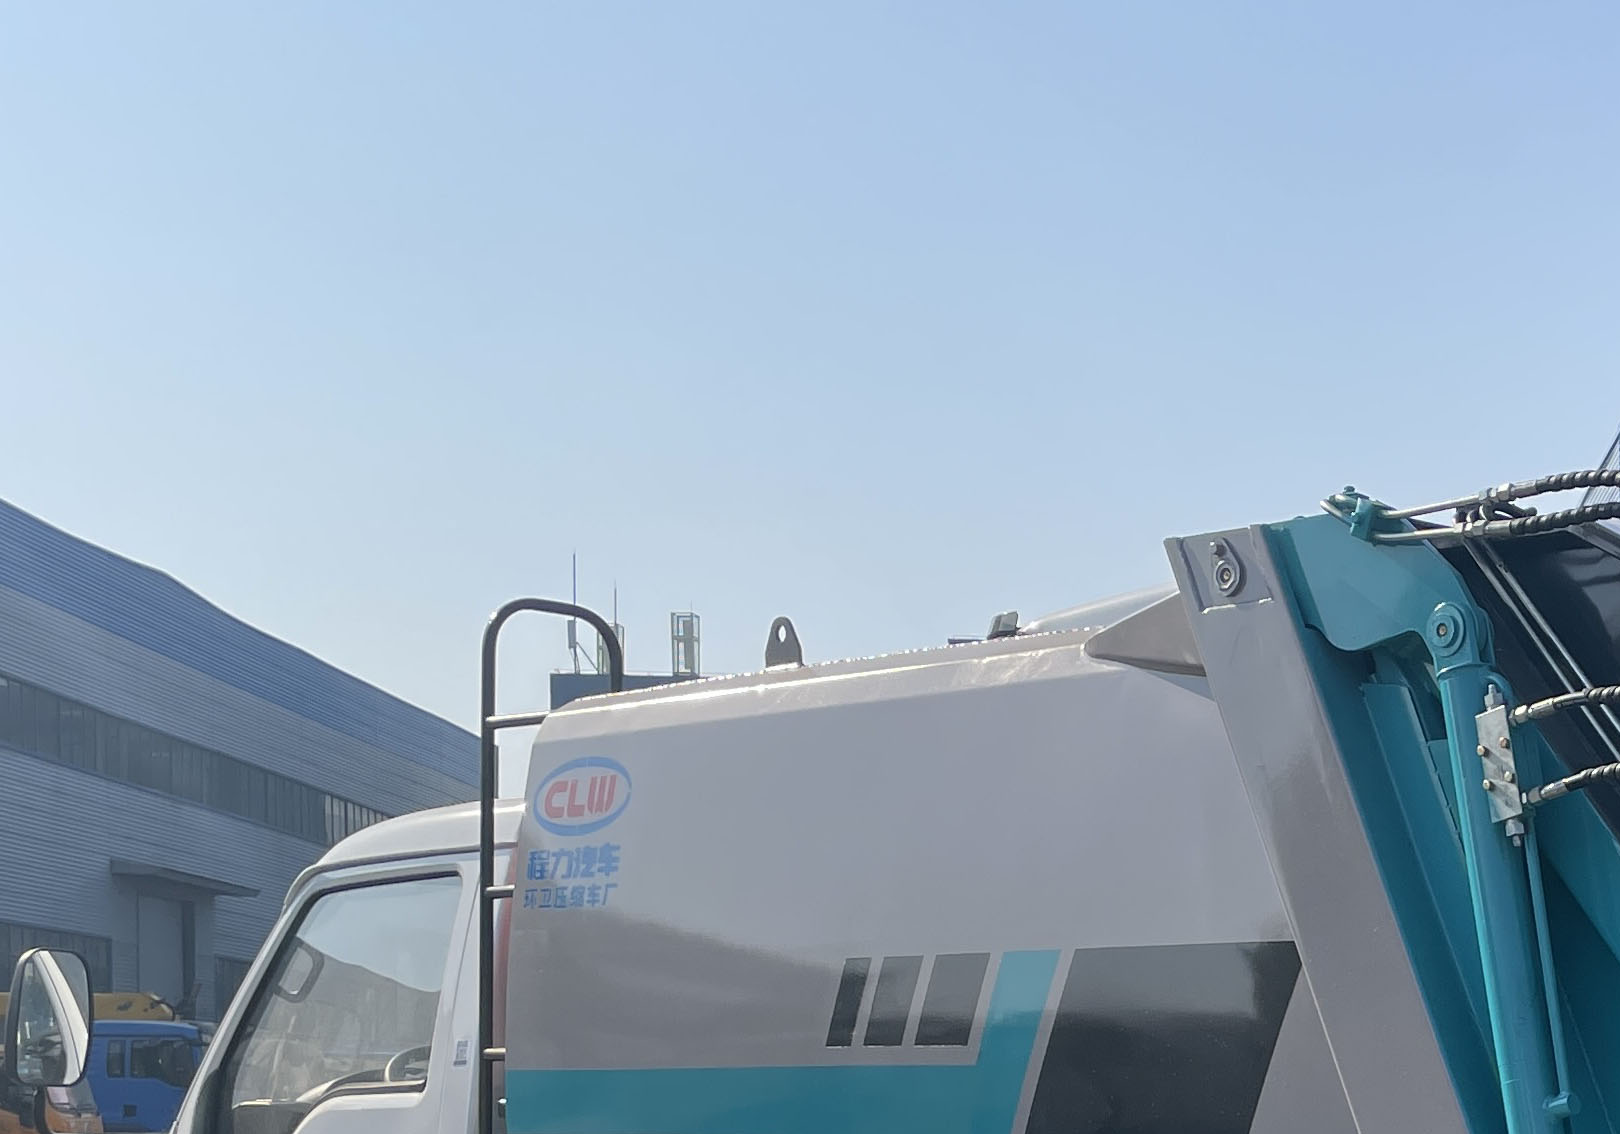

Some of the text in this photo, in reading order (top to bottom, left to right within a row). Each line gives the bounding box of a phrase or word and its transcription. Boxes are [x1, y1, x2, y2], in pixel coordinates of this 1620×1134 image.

[544, 774, 618, 819] CLW
[526, 842, 621, 881] 程力汽车
[523, 883, 618, 909] 环卫压缩车厂
